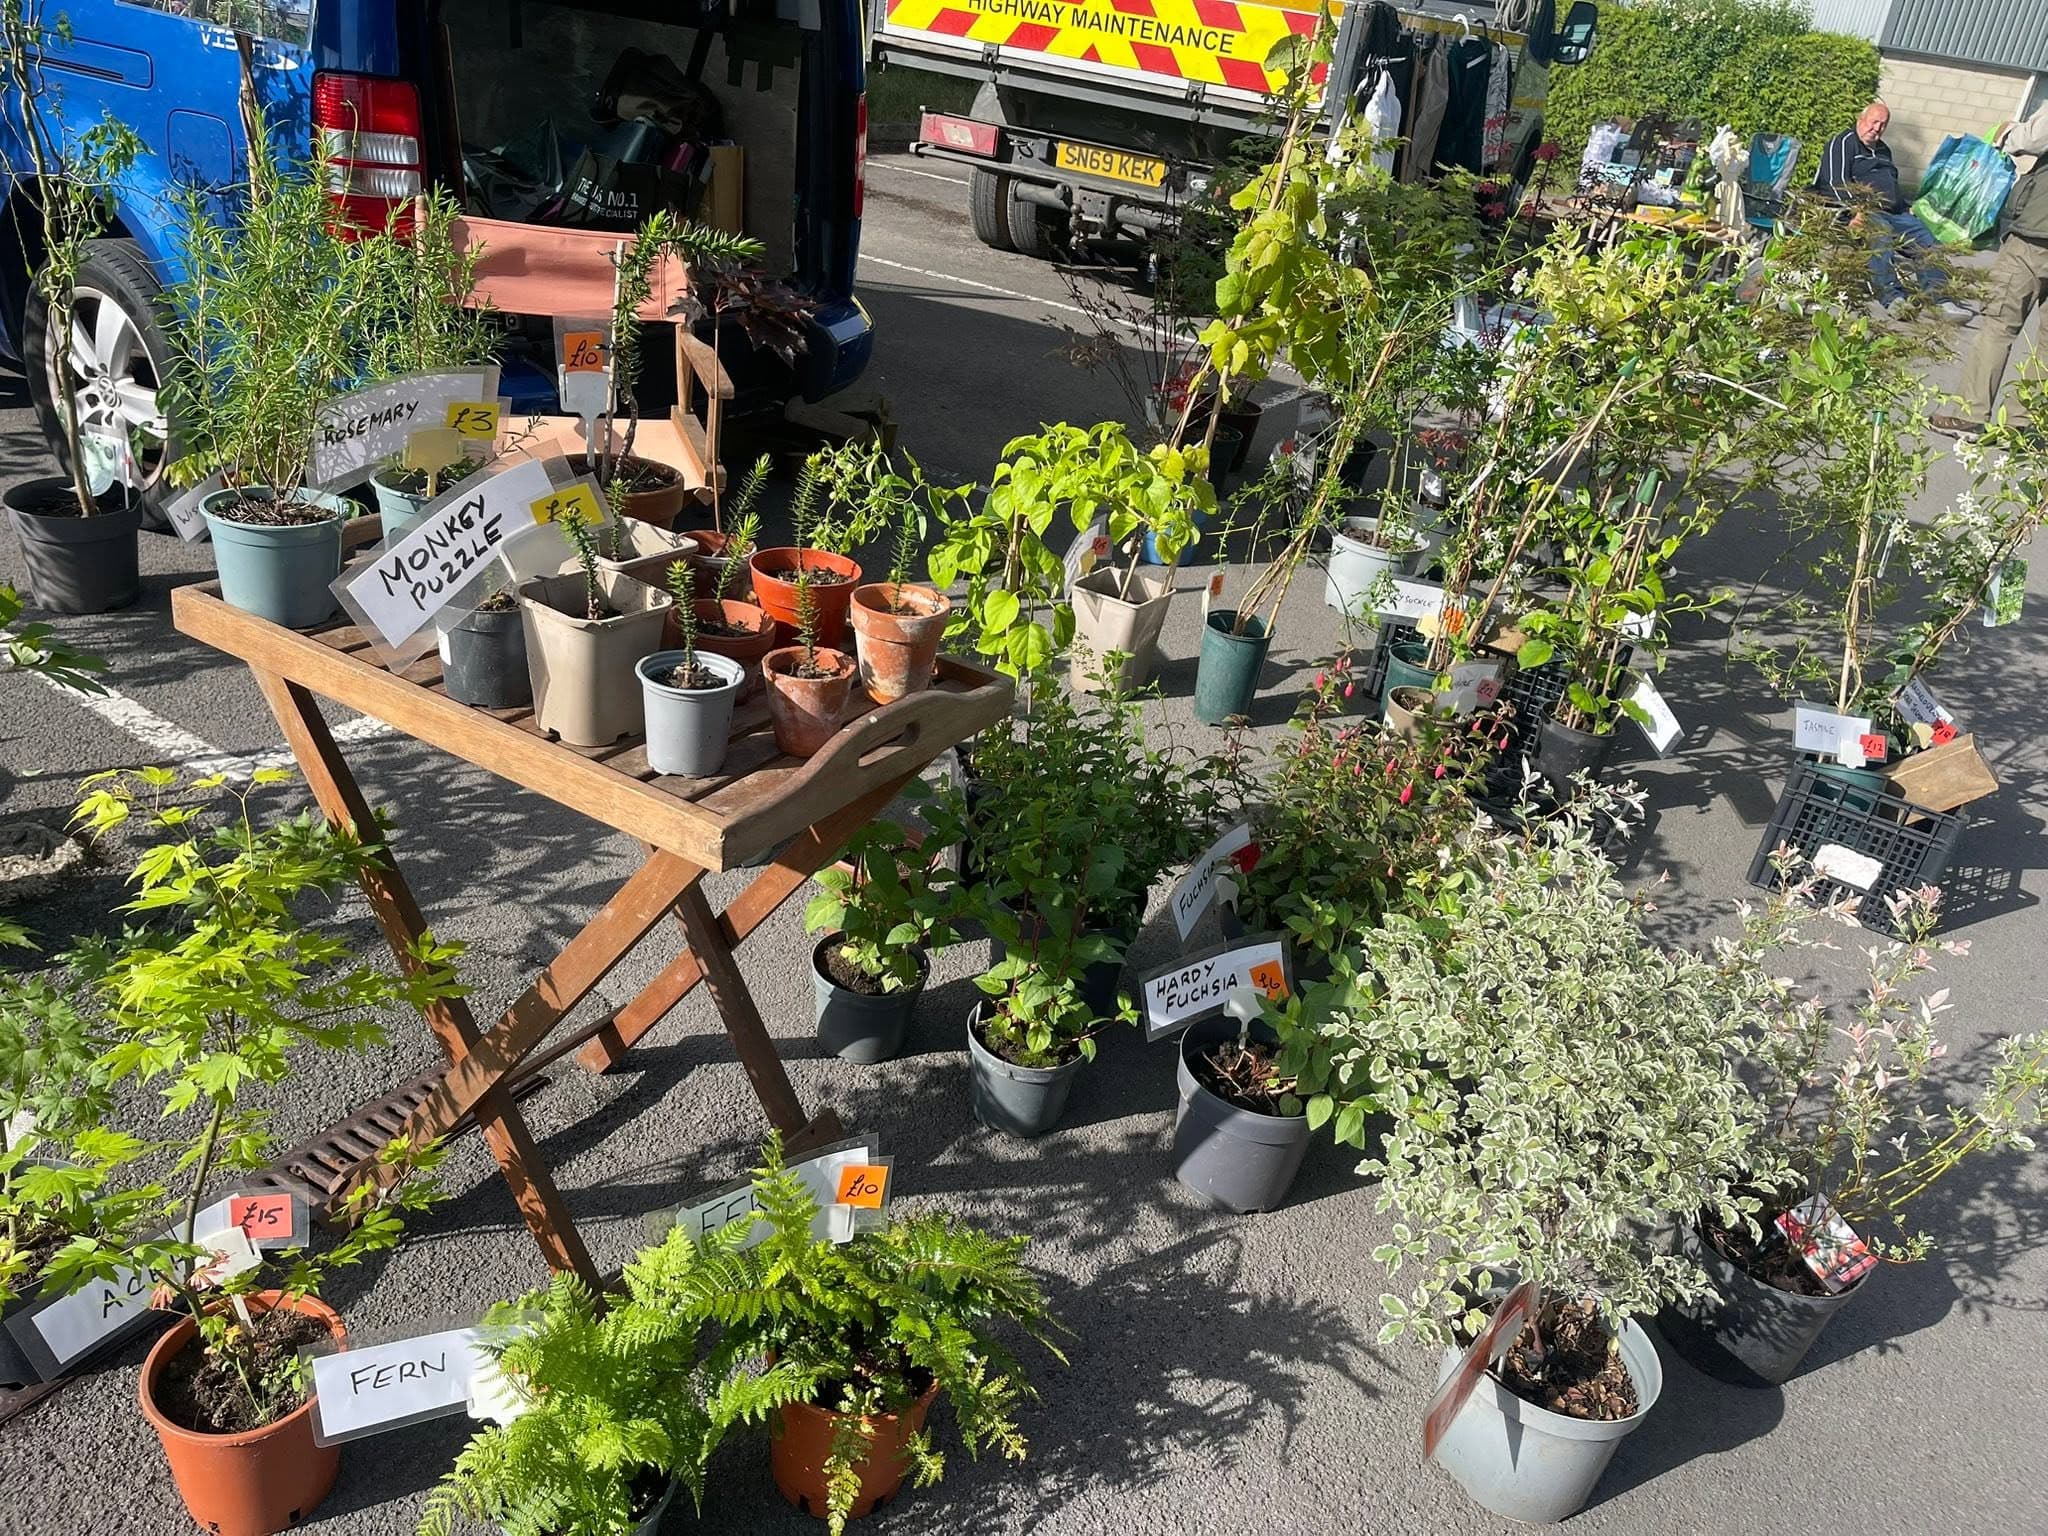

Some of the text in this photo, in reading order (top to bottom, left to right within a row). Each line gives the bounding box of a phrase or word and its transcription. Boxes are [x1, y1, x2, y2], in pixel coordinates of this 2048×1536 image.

[969, 0, 1235, 54] HIGHWAY MAINTENANCE
[1065, 144, 1157, 182] SN69 KEK
[607, 191, 639, 208] NO.1
[569, 339, 598, 367] £10
[324, 401, 419, 447] ROSEMARY
[452, 408, 492, 433] £3
[378, 494, 485, 597] MONKEY
[409, 512, 502, 611] PUZZLE
[1864, 740, 1883, 753] £12
[1179, 860, 1216, 920] FUCHSIA
[1156, 961, 1216, 998] HARDY
[1165, 973, 1239, 1014] FUCHSIA
[1258, 972, 1281, 990] £6
[845, 1174, 879, 1198] £10
[240, 1202, 283, 1229] £15
[701, 1187, 769, 1233] FER
[350, 1352, 446, 1395] FERN
